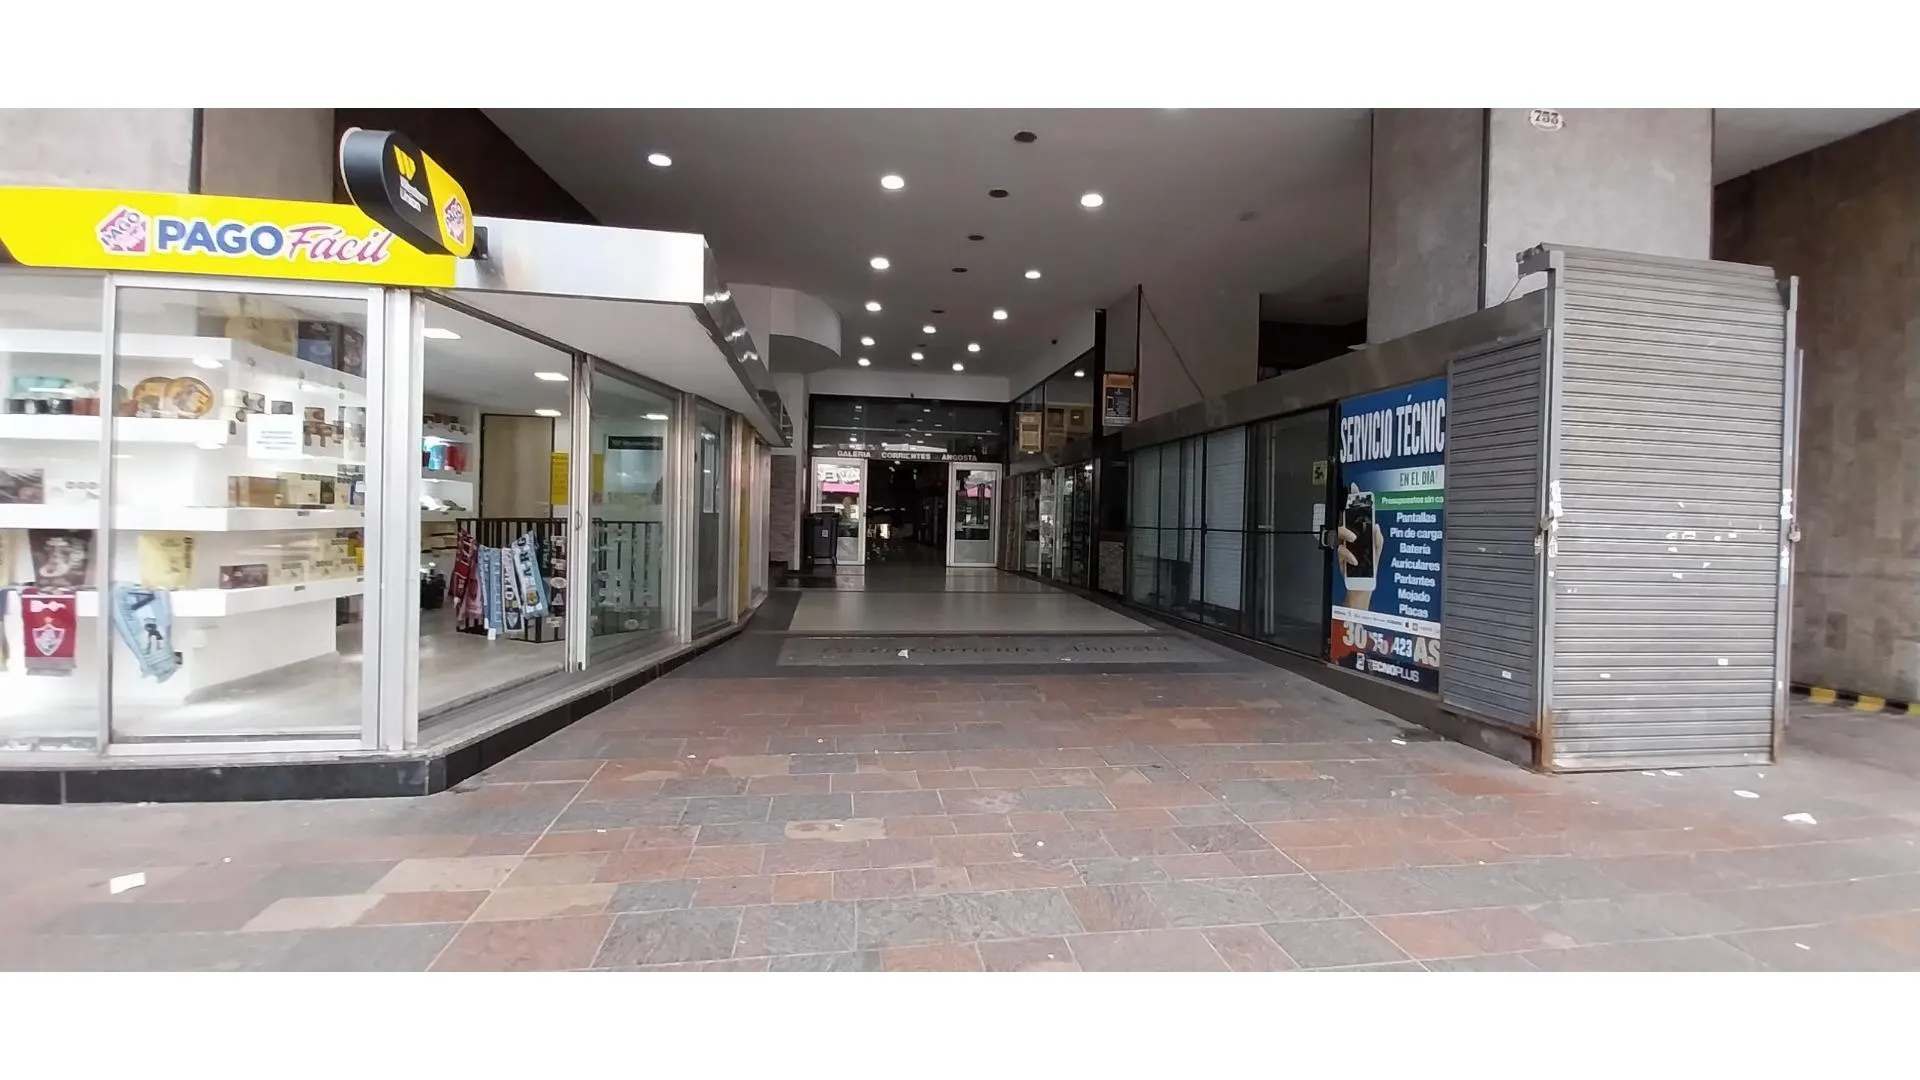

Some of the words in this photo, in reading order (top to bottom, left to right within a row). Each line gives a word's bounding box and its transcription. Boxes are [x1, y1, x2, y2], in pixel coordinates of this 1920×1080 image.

[158, 219, 284, 256] PAGO
[289, 226, 392, 262] Fácil
[1340, 408, 1393, 464] SERVICIO
[1396, 394, 1446, 456] TÉCNIC
[881, 452, 931, 460] CORRIENTES
[1400, 473, 1410, 487] EN
[1412, 472, 1420, 486] EL
[1381, 497, 1424, 506] Presupuestos
[1396, 512, 1437, 523] Pantallas
[1390, 527, 1403, 538] Pin
[1404, 528, 1416, 539] de
[1416, 529, 1443, 541] carga
[1399, 542, 1431, 554] Batería
[1391, 557, 1440, 571] Auriculares
[1394, 572, 1435, 587] Parlantes
[1398, 588, 1430, 602] Mojado
[1399, 603, 1429, 618] Placas
